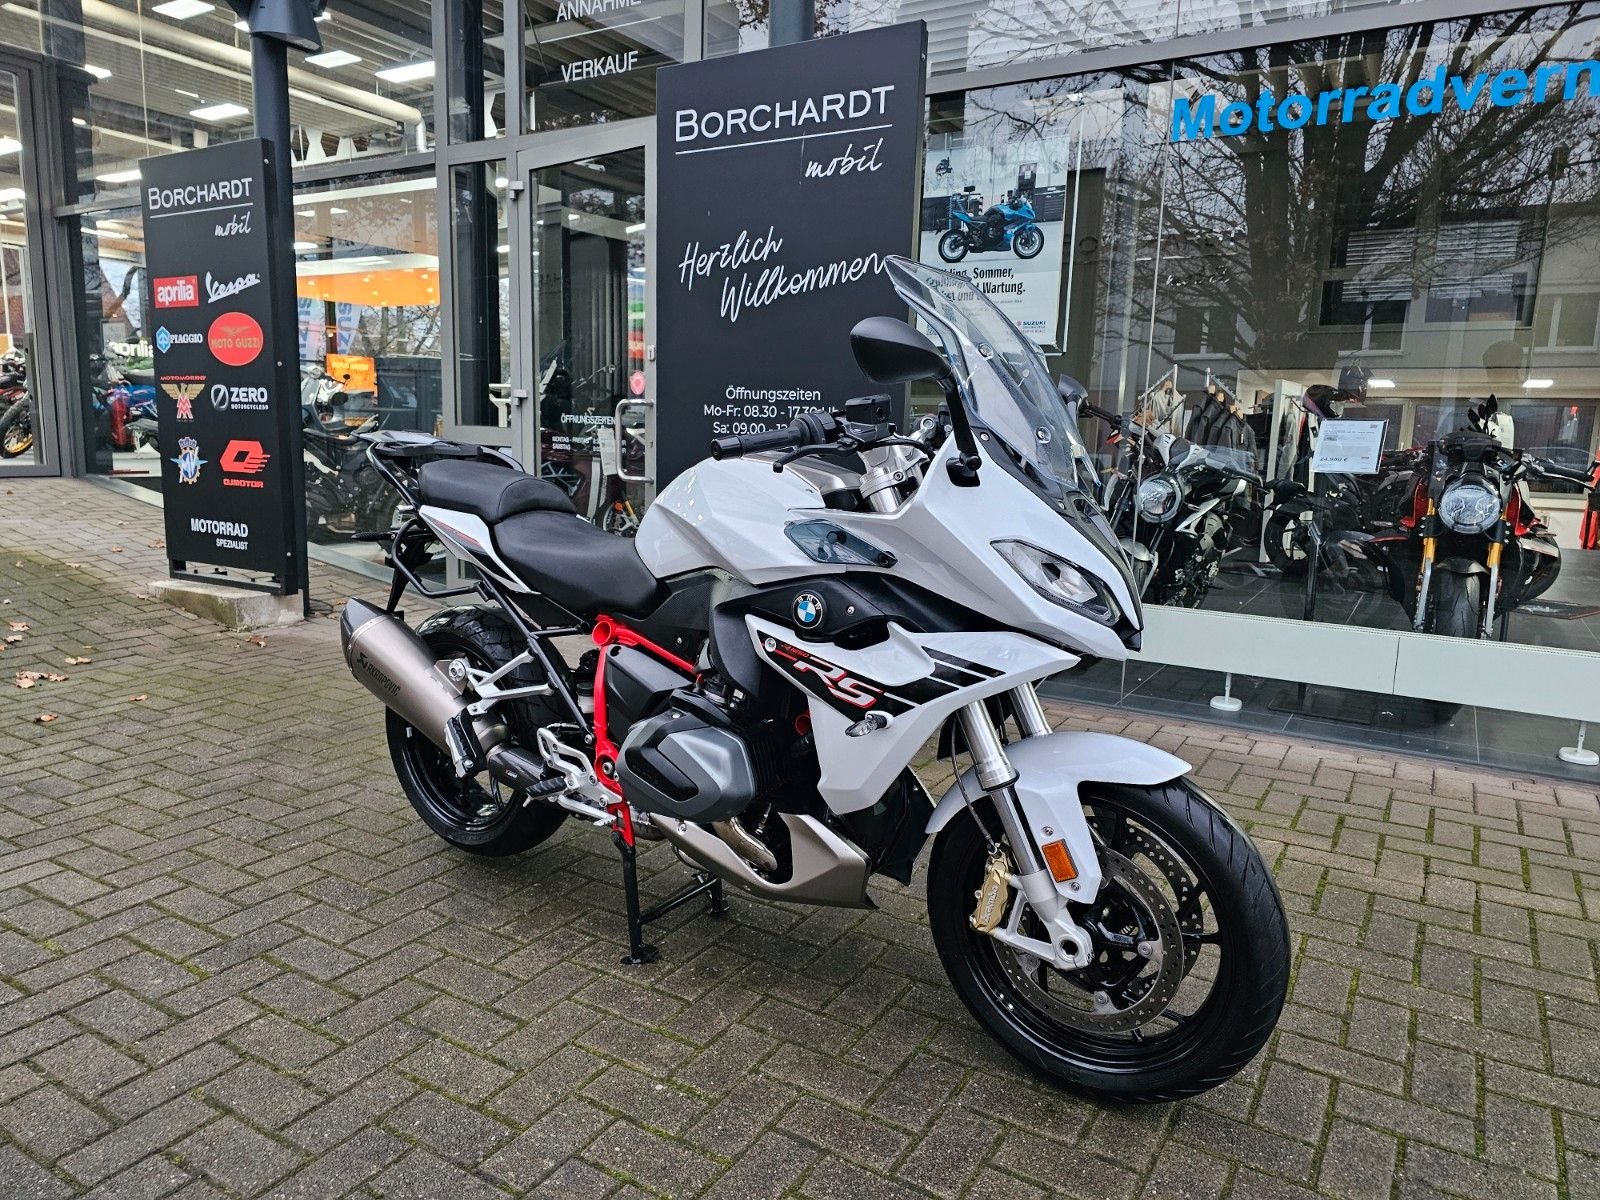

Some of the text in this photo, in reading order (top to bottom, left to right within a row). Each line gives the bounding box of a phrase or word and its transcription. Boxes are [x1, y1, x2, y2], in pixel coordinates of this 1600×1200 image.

[556, 0, 642, 23] ANNAH
[561, 50, 639, 83] VERKAUF
[1170, 59, 1600, 143] Motorradvern
[675, 84, 895, 143] BORCHARDT
[804, 137, 884, 178] mobil
[148, 177, 253, 210] BORCHARDT
[214, 210, 252, 237] mobil
[678, 225, 783, 291] Herzlich
[973, 267, 1014, 280] Sommer,
[157, 280, 194, 305] aprilia
[205, 271, 261, 304] Vespa
[720, 252, 886, 323] Willkommen
[982, 281, 1027, 295] Wartung.
[170, 333, 204, 344] PIAGGIO
[212, 337, 260, 349] MOTO GUZZI
[230, 387, 268, 402] ZERO
[725, 385, 821, 403] Öffnungszeiten
[703, 404, 741, 417] Mo-Fr:
[743, 405, 778, 418] 08.30
[712, 421, 730, 434] Sa:
[732, 422, 766, 435] 09.00
[190, 517, 249, 538] MOTORRAD
[216, 538, 249, 550] SPEZIALIST
[793, 657, 883, 708] RS
